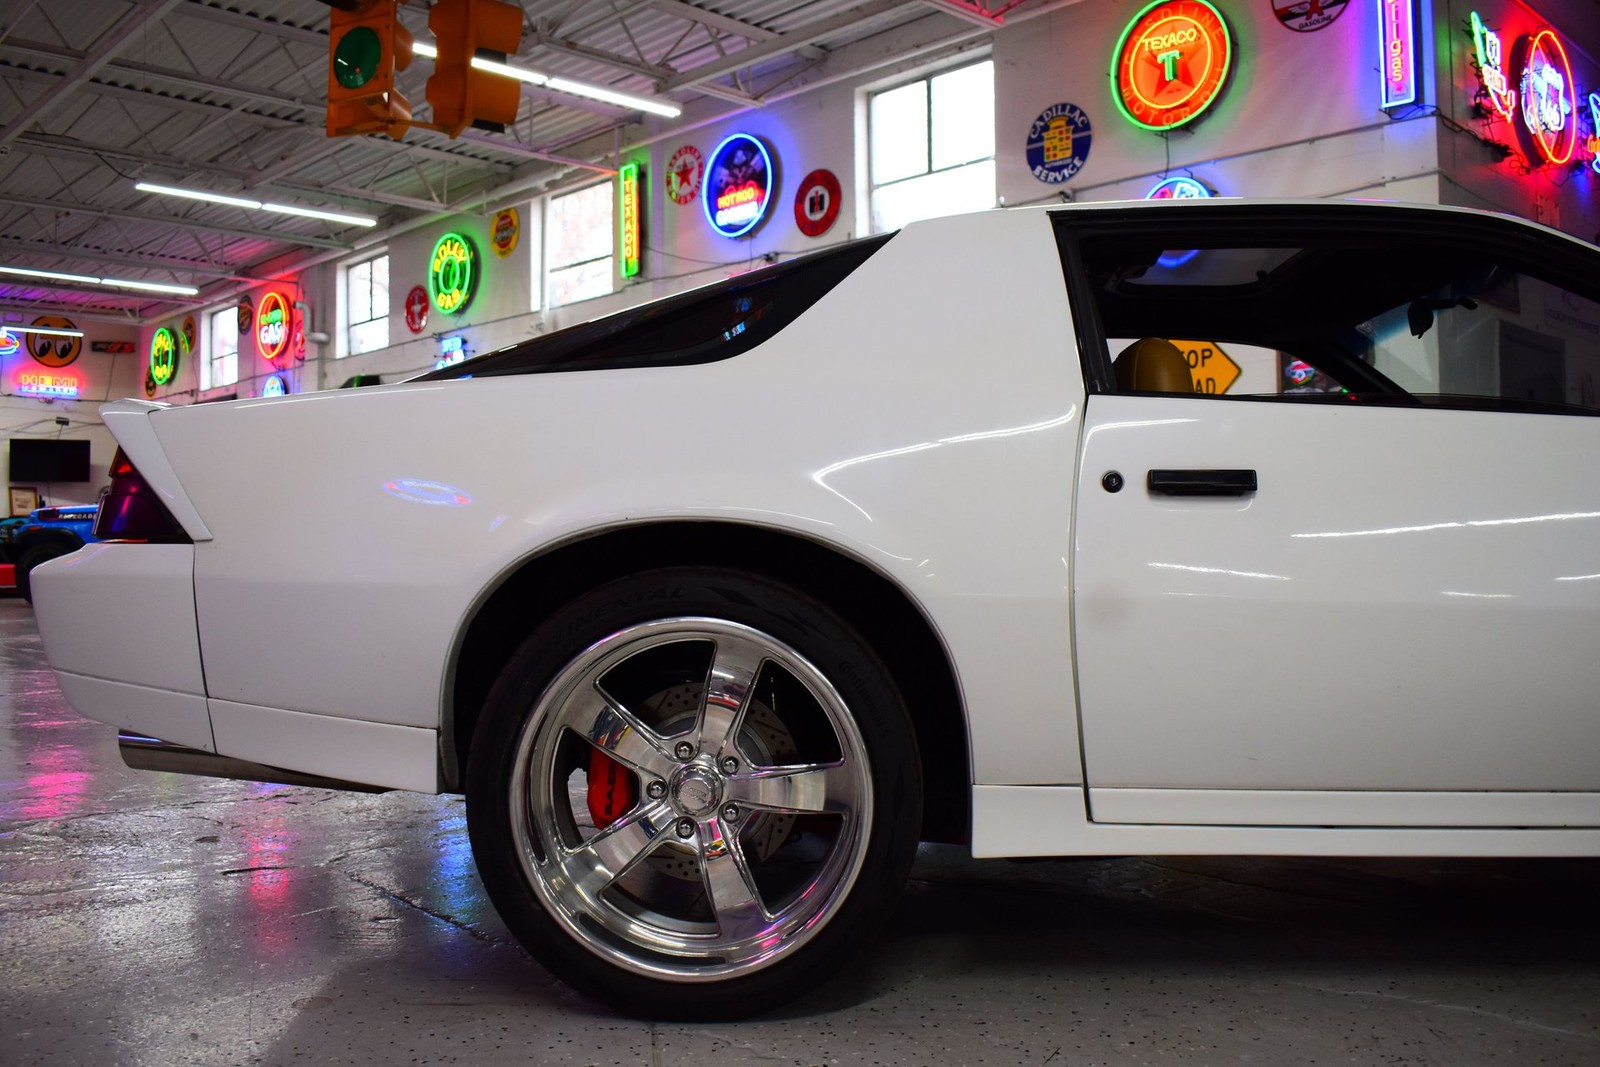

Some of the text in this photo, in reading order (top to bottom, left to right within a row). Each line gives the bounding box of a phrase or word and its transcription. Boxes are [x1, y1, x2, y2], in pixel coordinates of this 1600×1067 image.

[1298, 14, 1332, 30] GASOLINE
[1142, 27, 1197, 51] TEXACO
[1122, 88, 1191, 126] MOTOR
[1030, 104, 1088, 139] CADILLAC
[1033, 156, 1083, 183] SERVICE
[623, 180, 633, 258] TEXACO
[433, 240, 466, 273] POLLY
[437, 288, 461, 309] GAS
[260, 321, 283, 345] GAS
[1181, 350, 1213, 368] OP
[21, 374, 77, 388] HEMI
